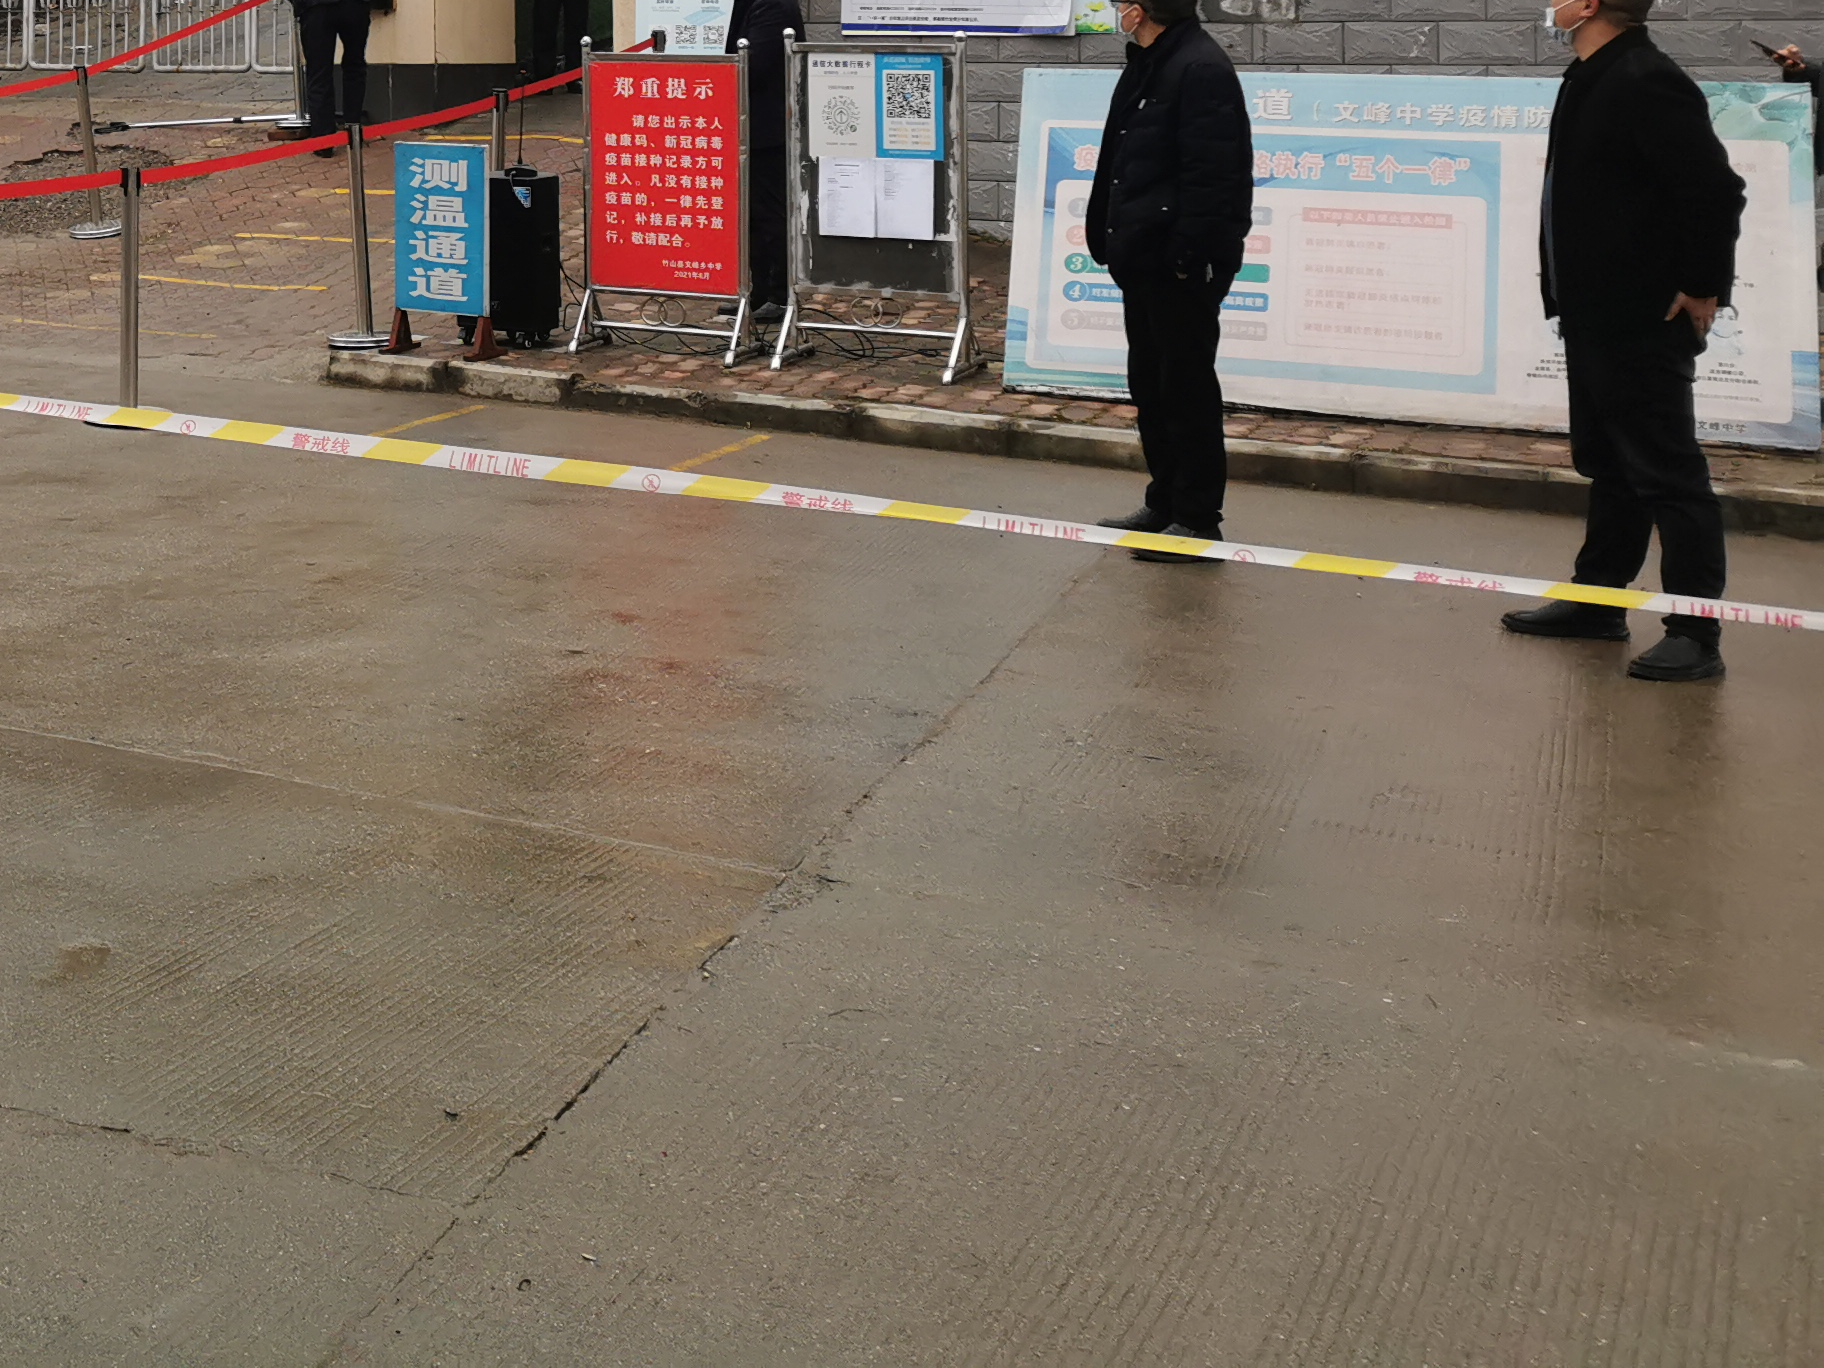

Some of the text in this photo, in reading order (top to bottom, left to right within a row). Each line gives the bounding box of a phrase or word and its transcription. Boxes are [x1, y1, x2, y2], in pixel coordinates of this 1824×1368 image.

[812, 60, 872, 69] 通信大数据行程卡
[613, 77, 715, 100] 郑重提示
[1252, 88, 1293, 121] 道
[631, 115, 724, 130] 请您出示本人
[604, 133, 724, 151] 健康码、新冠病毒
[604, 153, 724, 170] 疫苗接种记录方可
[605, 172, 724, 190] 进入。凡没有接种
[605, 191, 724, 210] 疫苗的，一律先登
[408, 157, 469, 302] 测温通道
[605, 211, 724, 230] 记，补接后再予放
[605, 230, 691, 248] 行，敬请配合。
[662, 259, 723, 271] 竹山县文峰乡中学
[291, 432, 351, 455] 警戒线
[448, 449, 532, 478] LIMITLINE
